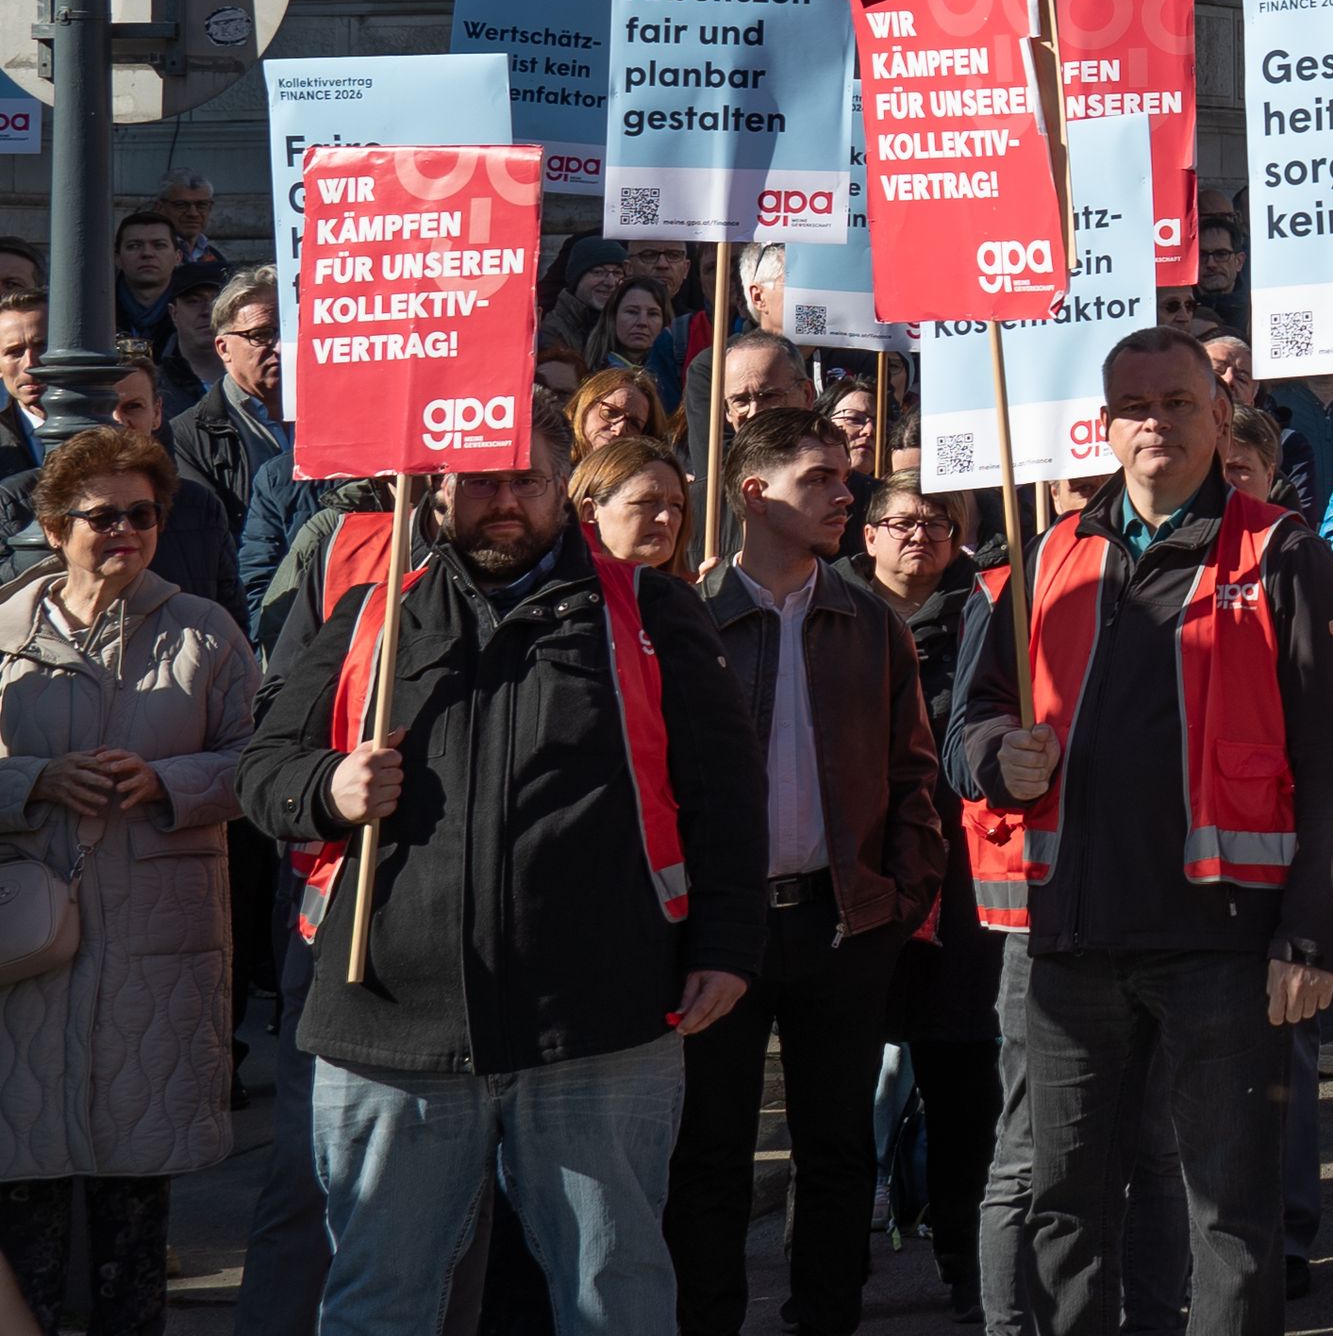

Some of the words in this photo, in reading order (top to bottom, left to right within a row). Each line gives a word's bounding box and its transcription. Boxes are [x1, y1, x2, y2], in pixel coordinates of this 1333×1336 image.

[463, 20, 602, 49] Wertschätz-
[626, 16, 688, 44] fair
[700, 20, 764, 46] und
[866, 10, 916, 38] WIR
[512, 54, 538, 73] ist
[544, 56, 591, 78] kein
[625, 60, 766, 93] planbar
[871, 46, 988, 80] KÄMPFEN
[278, 77, 373, 89] Kollektivvertrag
[280, 90, 332, 101] FINANCE
[334, 89, 363, 100] 2026
[510, 86, 607, 108] enfaktor
[876, 86, 926, 121] FÜR
[1067, 91, 1182, 118] NSEREN
[623, 105, 786, 137] gestalten
[878, 129, 1020, 161] KOLLEKTIV-
[546, 154, 601, 182] gpa
[317, 176, 375, 204] WIR
[880, 170, 999, 201] VERTRAG!
[663, 218, 740, 228] meine.gpa.at/finance
[756, 189, 833, 227] gpa
[317, 211, 461, 245] KÄMPFEN
[314, 251, 374, 285] FÜR
[382, 248, 525, 284] UNSEREN
[976, 239, 1054, 293] gpa
[1070, 250, 1113, 276] ein
[313, 290, 489, 324] KOLLEKTIV-
[934, 295, 1141, 338] Kosaktor
[312, 331, 458, 364] VERTRAG!
[422, 395, 515, 451] gpa
[1070, 419, 1109, 459] gp
